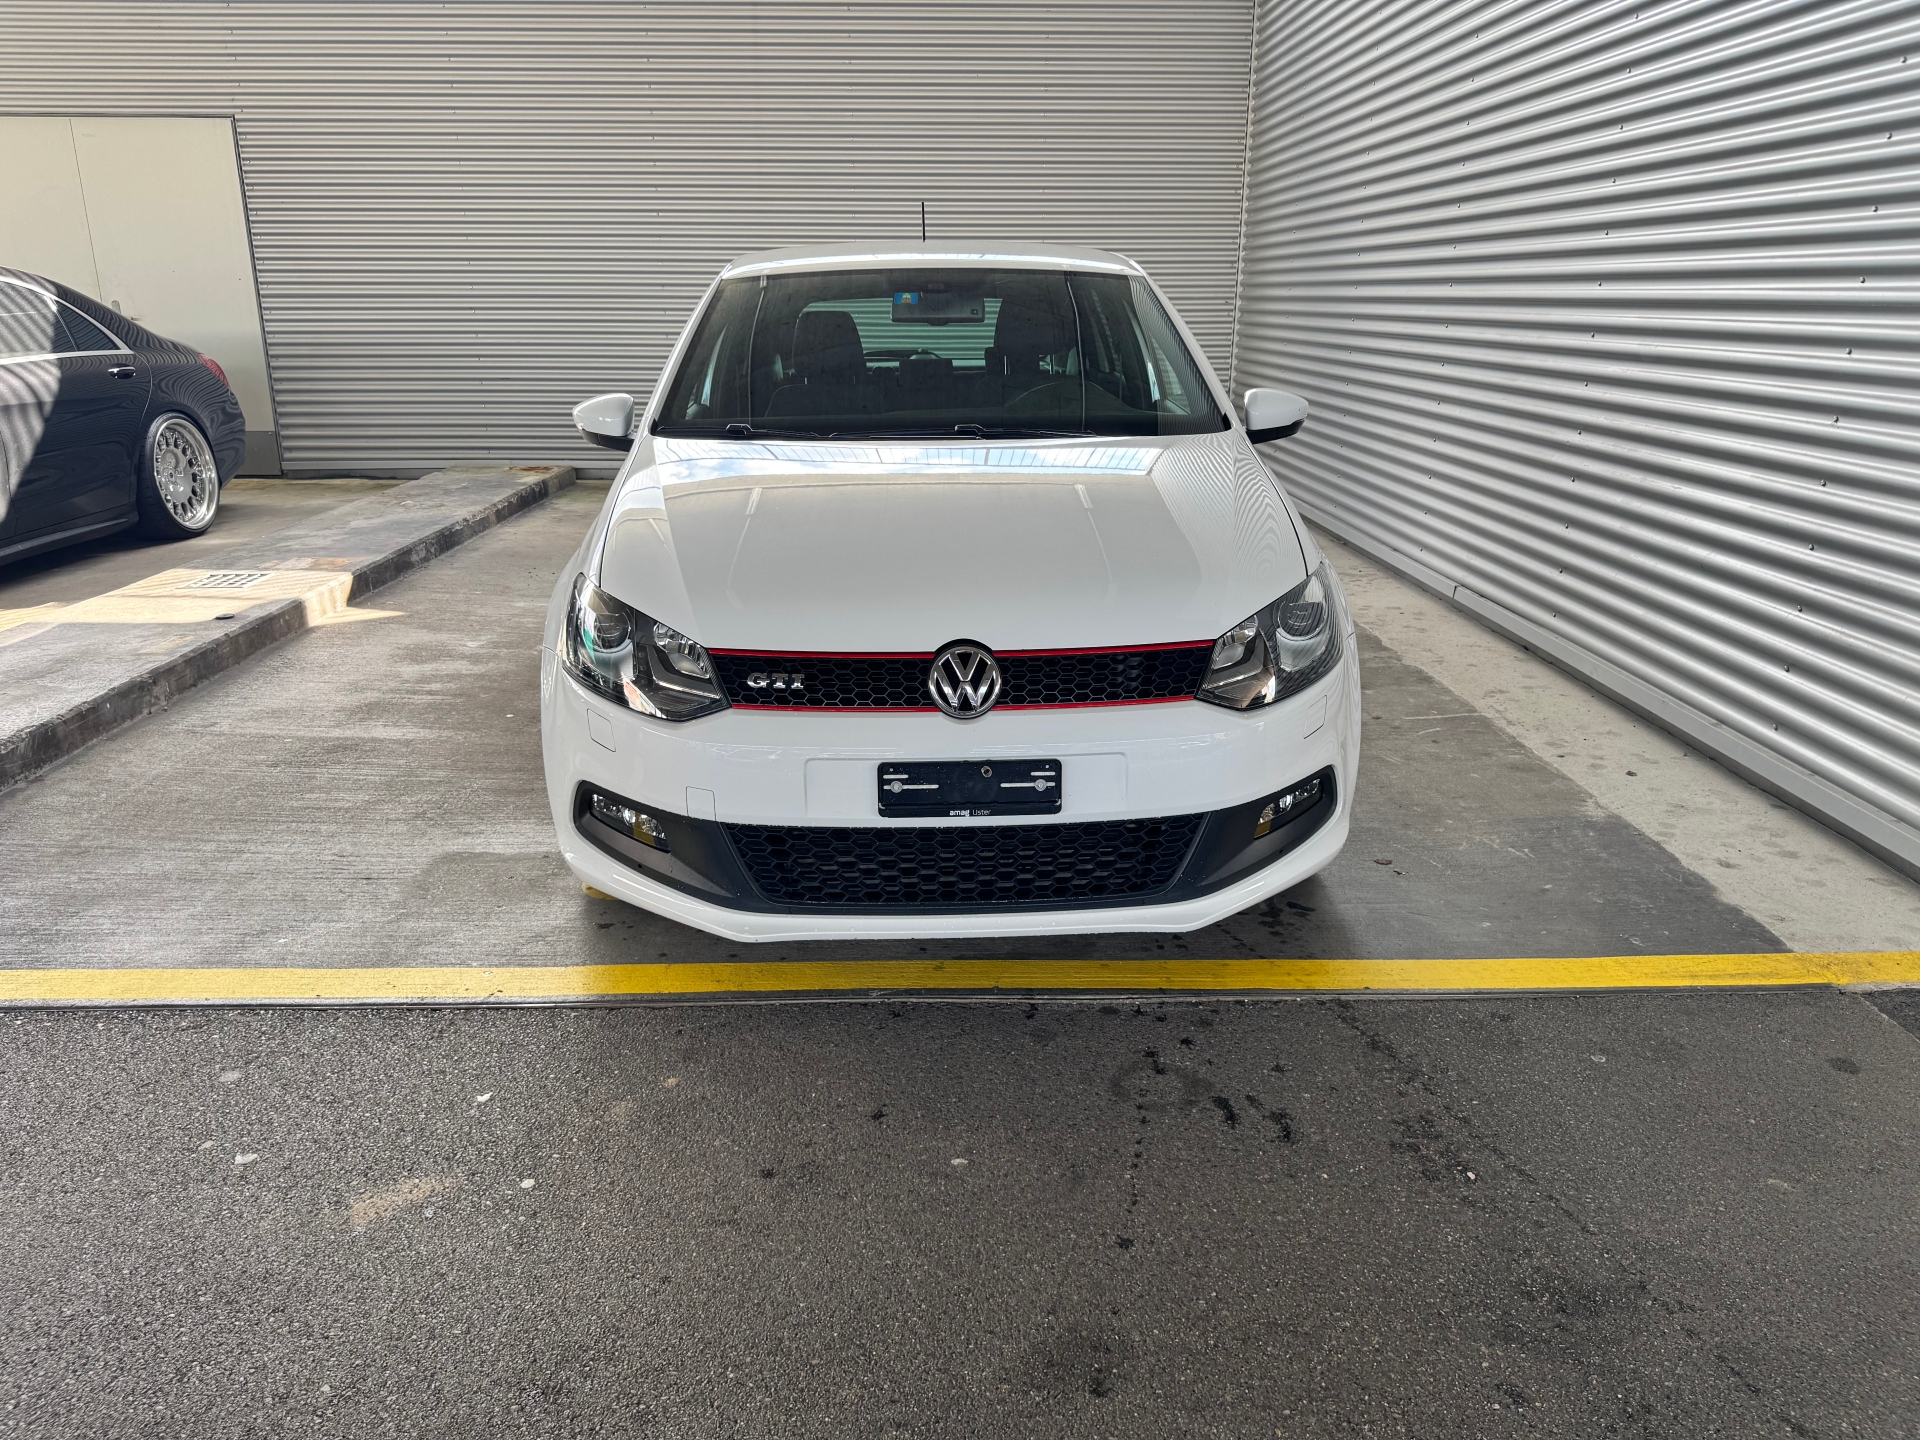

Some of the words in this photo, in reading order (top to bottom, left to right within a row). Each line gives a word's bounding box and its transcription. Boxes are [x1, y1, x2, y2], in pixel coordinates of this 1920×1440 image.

[747, 672, 805, 690] GTI
[934, 650, 996, 713] VW
[949, 809, 970, 817] amag
